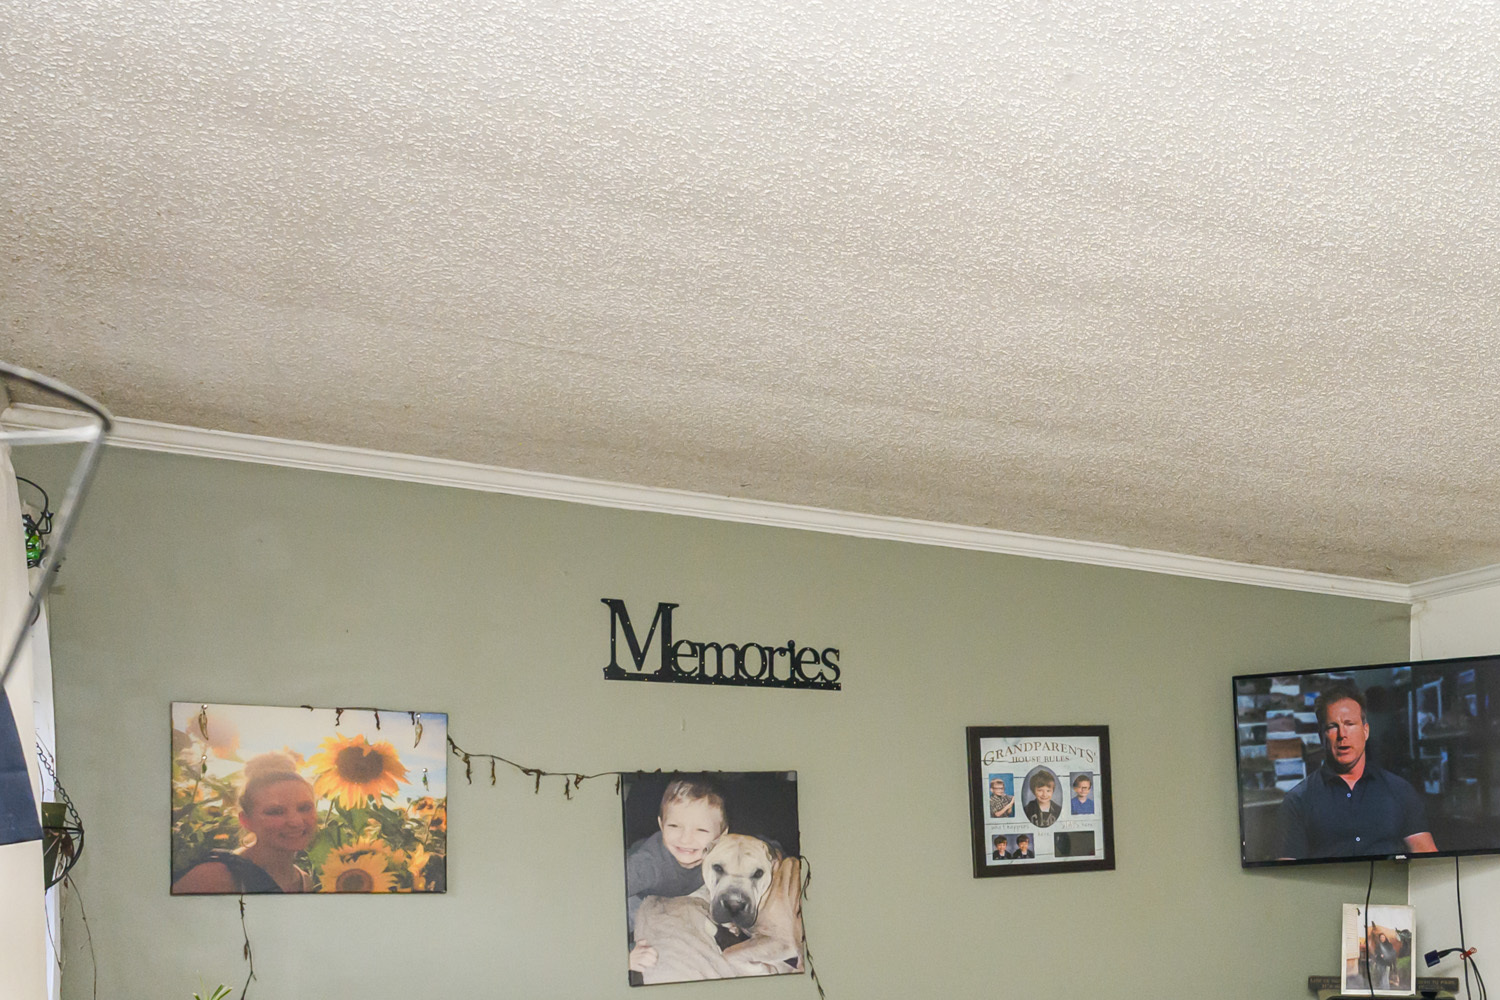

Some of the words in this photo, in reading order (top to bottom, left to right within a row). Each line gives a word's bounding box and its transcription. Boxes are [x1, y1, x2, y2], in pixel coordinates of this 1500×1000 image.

[601, 598, 841, 688] Memories
[1012, 755, 1040, 763] HOUSE
[1044, 755, 1070, 763] RULES
